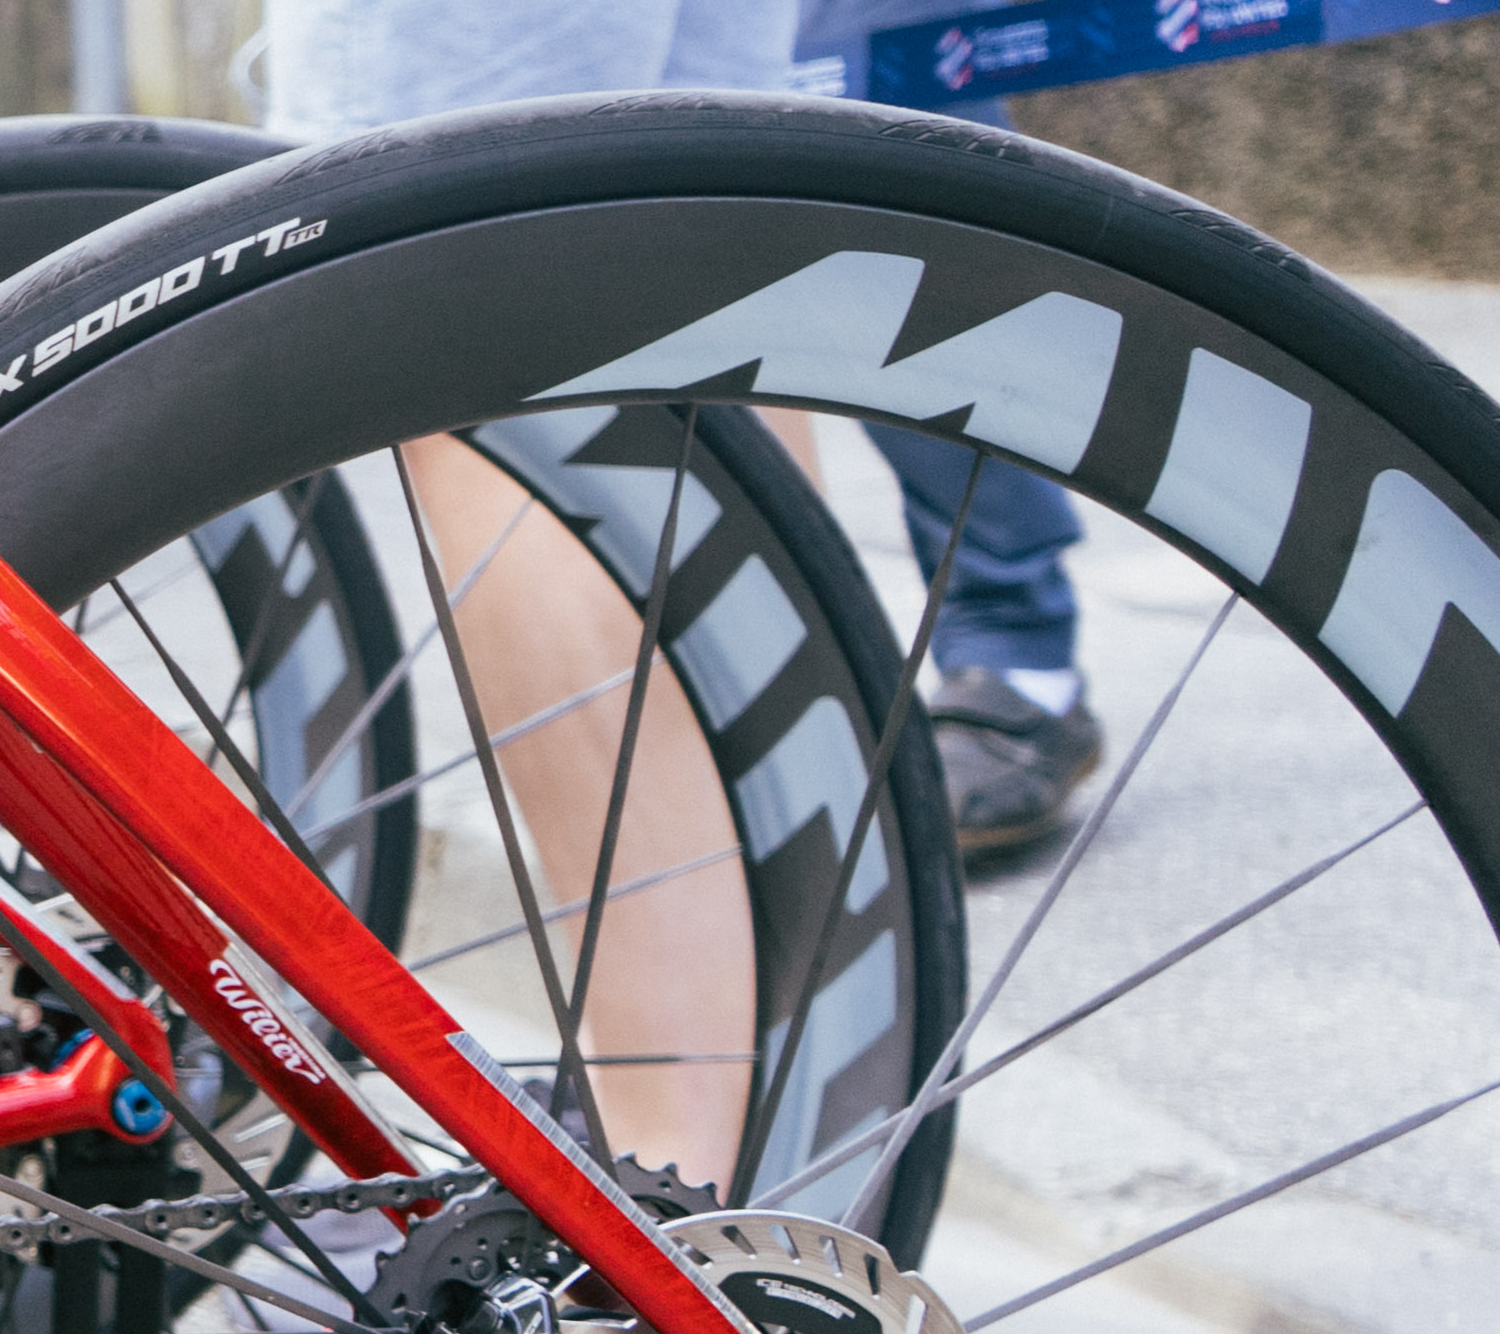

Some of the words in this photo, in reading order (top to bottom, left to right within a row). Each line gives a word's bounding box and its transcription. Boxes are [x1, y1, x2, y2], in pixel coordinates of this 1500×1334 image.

[32, 255, 206, 378] 5000
[212, 217, 301, 276] TT
[283, 219, 328, 250] TR
[208, 958, 321, 1085] Wilier
